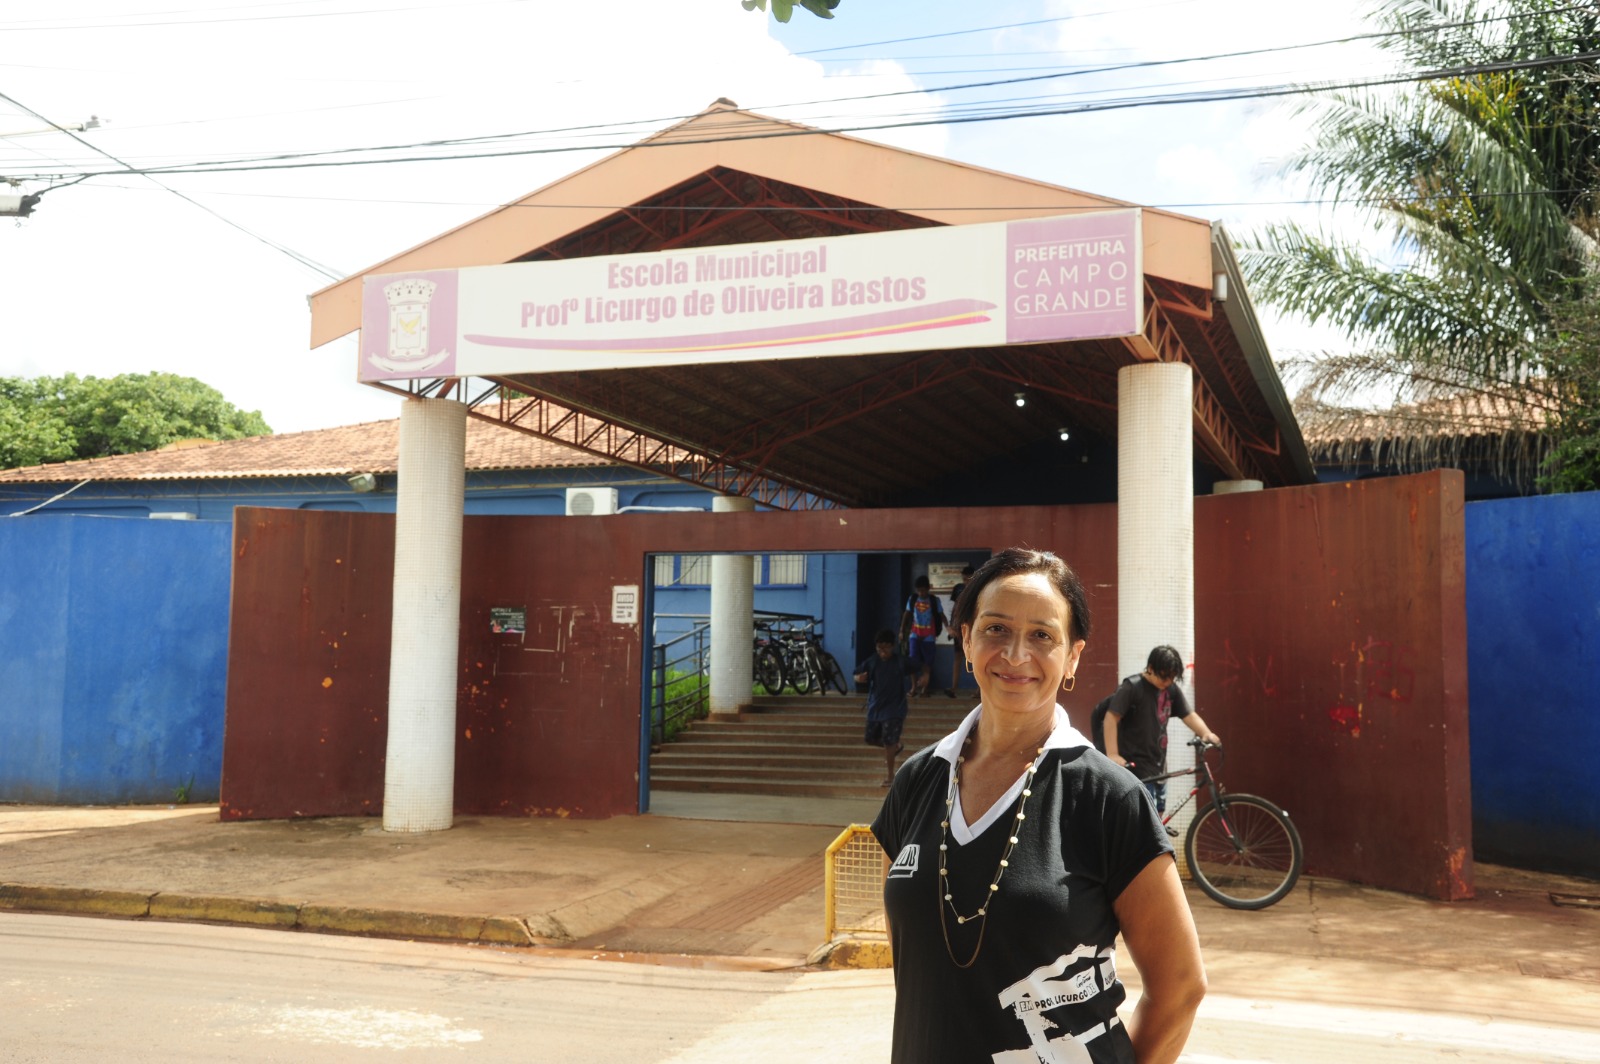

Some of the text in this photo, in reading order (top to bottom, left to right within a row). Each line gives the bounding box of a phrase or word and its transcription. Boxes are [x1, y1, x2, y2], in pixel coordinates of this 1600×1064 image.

[1015, 240, 1126, 264] PREFEITURA
[607, 245, 827, 289] Escola Municipal
[1014, 261, 1127, 289] CAMPO
[584, 295, 677, 324] Licurgo
[683, 289, 714, 318] de
[721, 281, 825, 315] Oliveira
[831, 275, 927, 307] Bastos
[1014, 286, 1127, 314] GRANDE
[1054, 989, 1089, 1005] LICURGO
